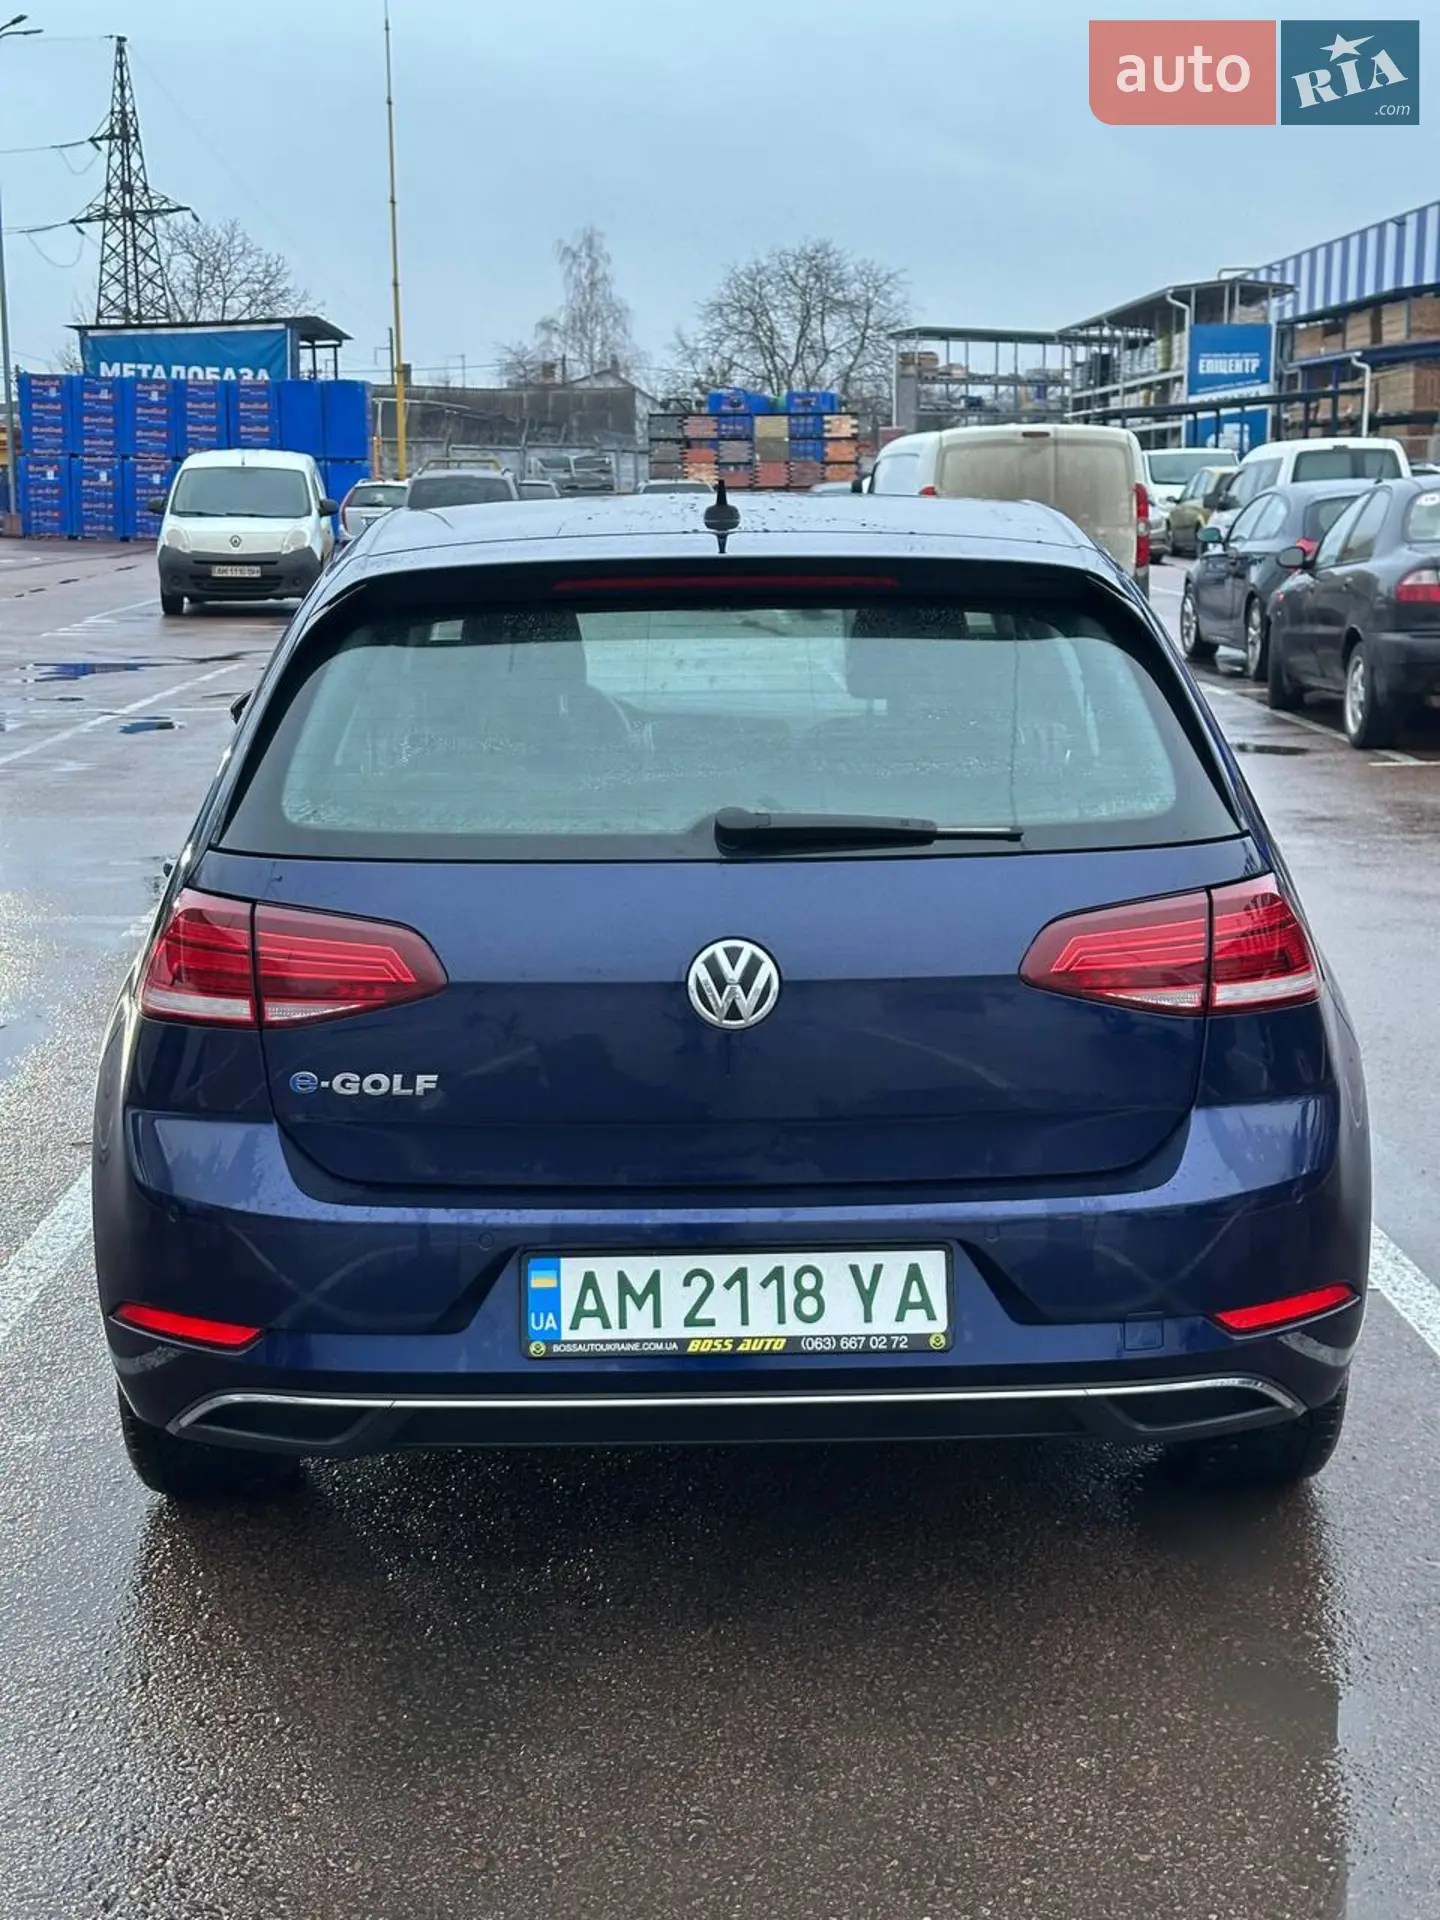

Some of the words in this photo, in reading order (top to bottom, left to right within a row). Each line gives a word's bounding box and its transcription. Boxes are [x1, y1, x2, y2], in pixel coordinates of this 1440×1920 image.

[289, 1070, 439, 1096] e-GOLF
[569, 1269, 662, 1330] AM
[682, 1265, 826, 1328] 2118
[848, 1262, 937, 1323] YA
[531, 1312, 558, 1331] UA
[553, 1341, 678, 1352] BOSSAUTOUKRAINE.COM.UA
[687, 1338, 733, 1352] BOSS
[736, 1337, 787, 1351] AUTO
[801, 1336, 836, 1350] (063)
[840, 1336, 867, 1349] 667
[869, 1336, 887, 1348] 02
[890, 1335, 908, 1348] 72
